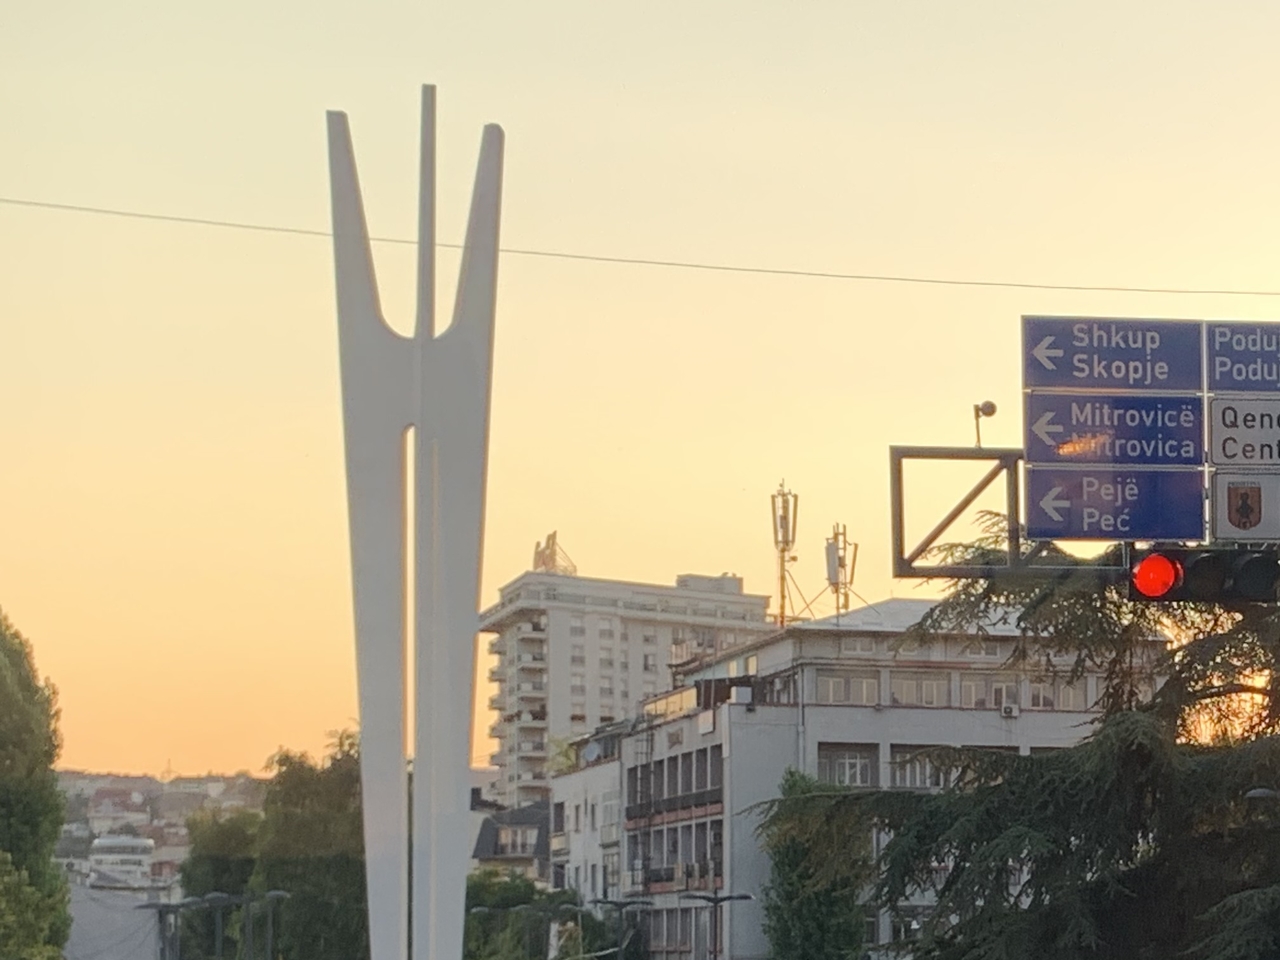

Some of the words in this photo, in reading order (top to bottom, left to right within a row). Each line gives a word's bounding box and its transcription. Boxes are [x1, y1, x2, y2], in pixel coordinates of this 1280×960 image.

[1072, 324, 1161, 351] Shkup
[1072, 354, 1169, 385] Skopje
[1071, 402, 1195, 428] Mitrovicë
[1082, 476, 1139, 507] Pejë
[1083, 505, 1131, 532] Peć
